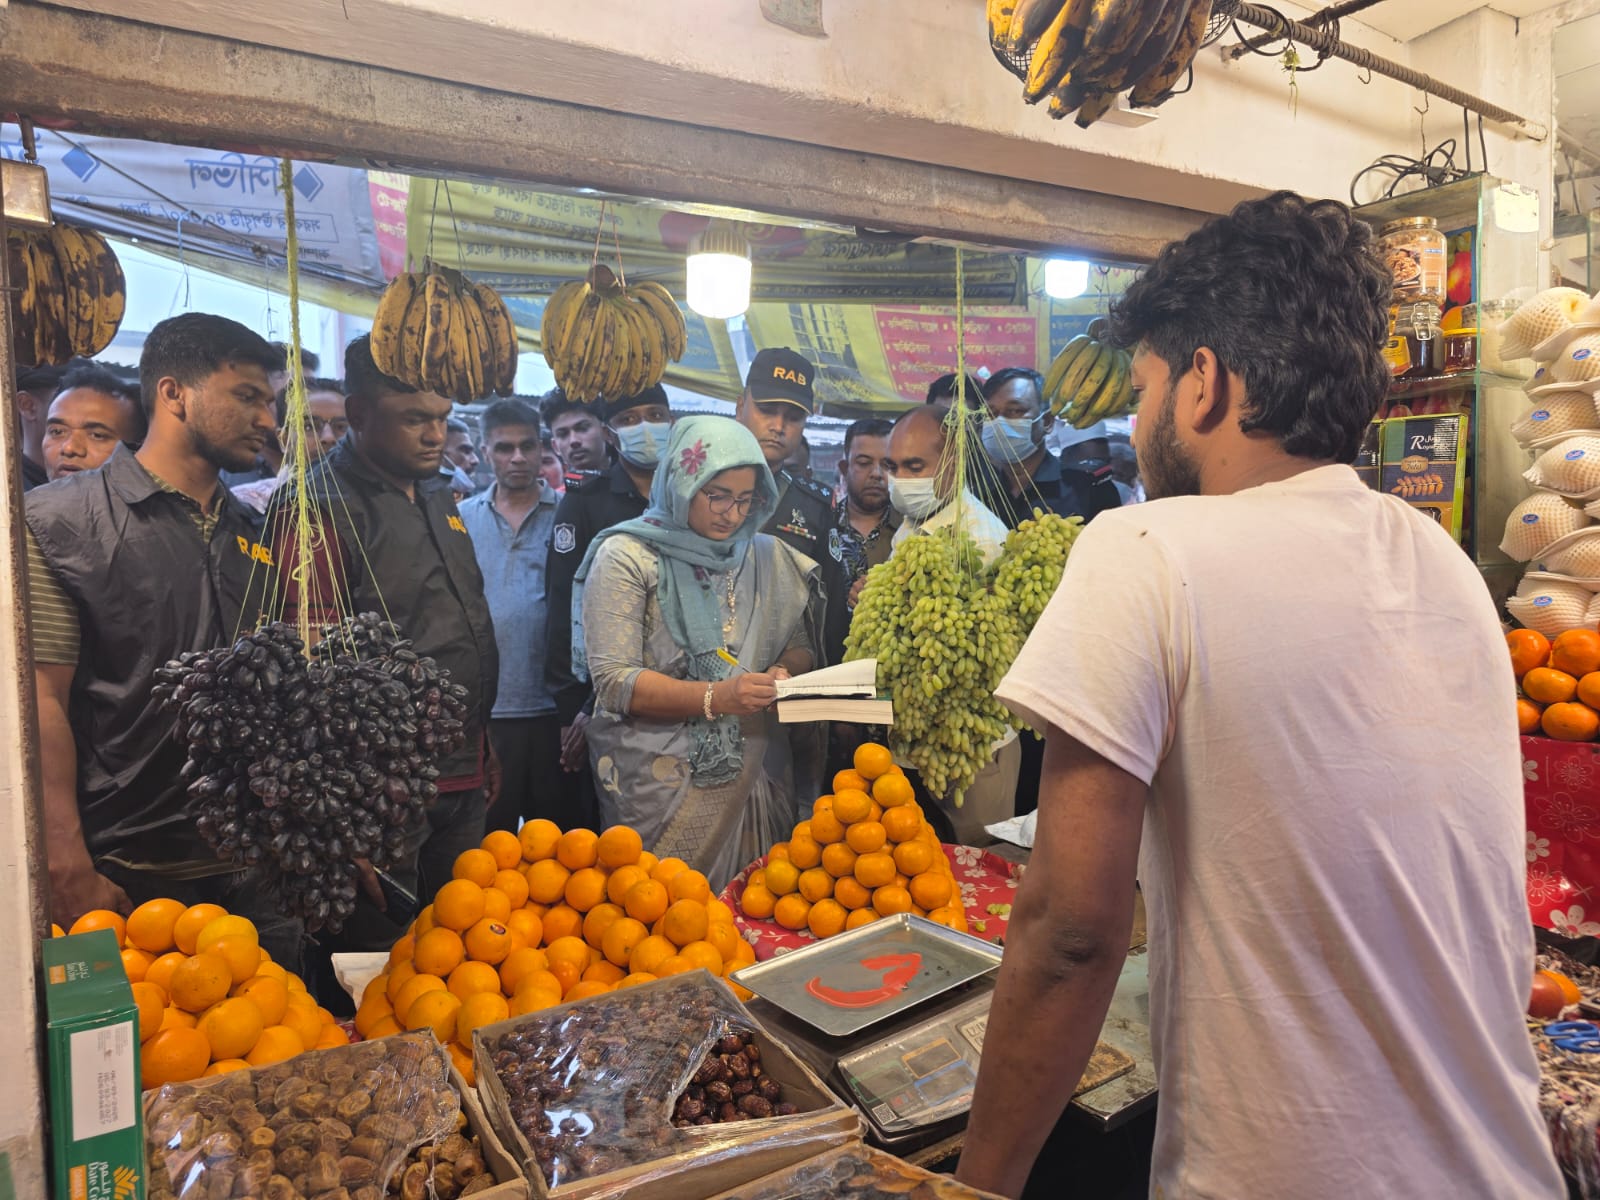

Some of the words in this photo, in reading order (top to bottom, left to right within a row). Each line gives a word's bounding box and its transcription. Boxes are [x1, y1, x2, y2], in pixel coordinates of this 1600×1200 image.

[773, 366, 807, 386] RAB
[236, 535, 275, 567] RAB
[87, 1161, 99, 1186] Date
